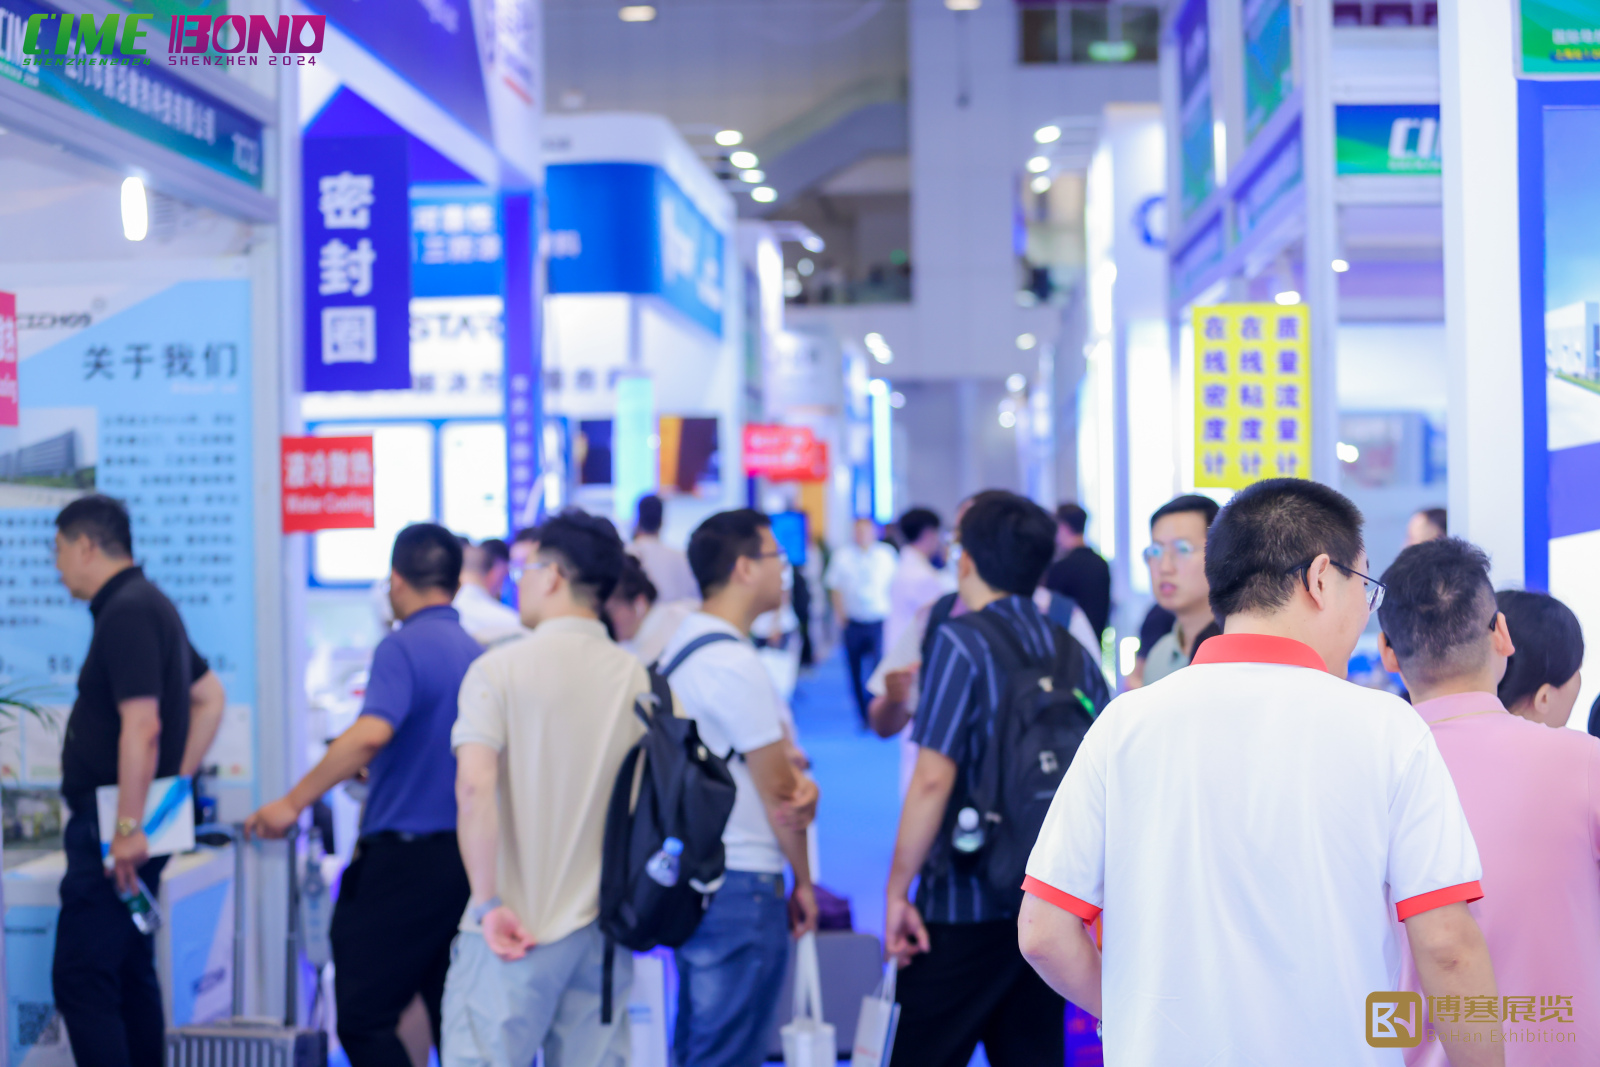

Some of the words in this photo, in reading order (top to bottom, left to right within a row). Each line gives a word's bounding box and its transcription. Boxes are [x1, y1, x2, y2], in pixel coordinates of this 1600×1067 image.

[318, 171, 377, 366] 密封圈
[83, 342, 239, 381] 关于我们
[1203, 315, 1228, 479] 在线密度计
[1239, 315, 1264, 479] 在线粘度计
[1276, 315, 1300, 478] 质量流量计
